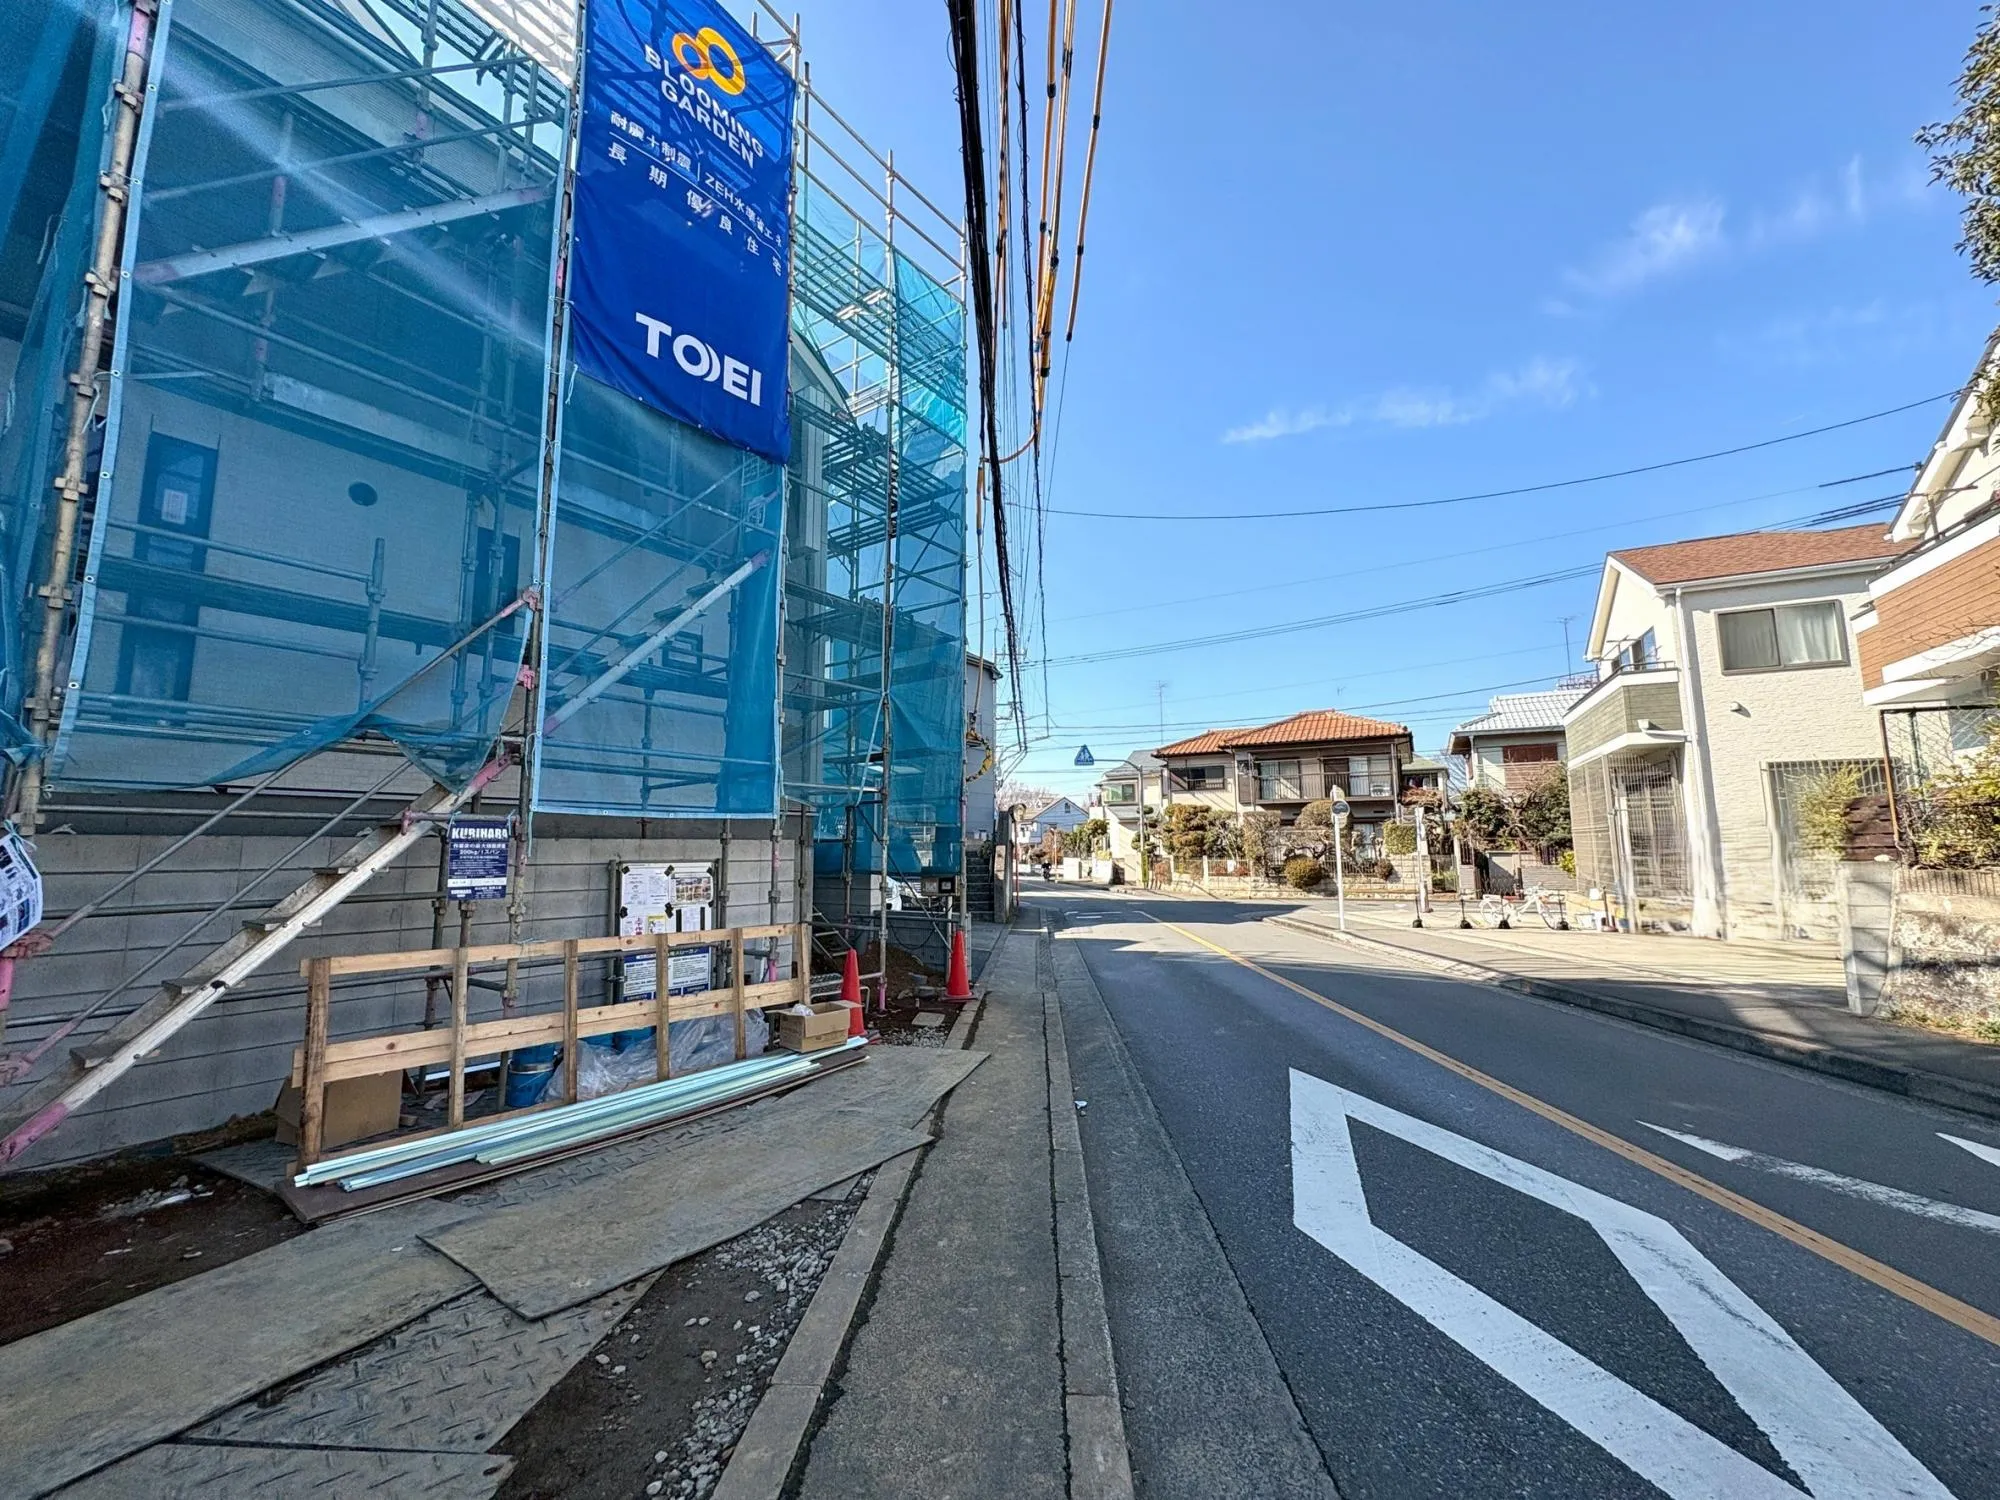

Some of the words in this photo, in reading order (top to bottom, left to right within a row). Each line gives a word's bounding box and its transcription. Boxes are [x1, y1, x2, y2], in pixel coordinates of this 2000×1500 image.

[645, 44, 763, 157] BLOOMING
[661, 80, 753, 168] GARDEN
[608, 142, 782, 276] 長期優良住宅
[635, 312, 762, 406] TOEI
